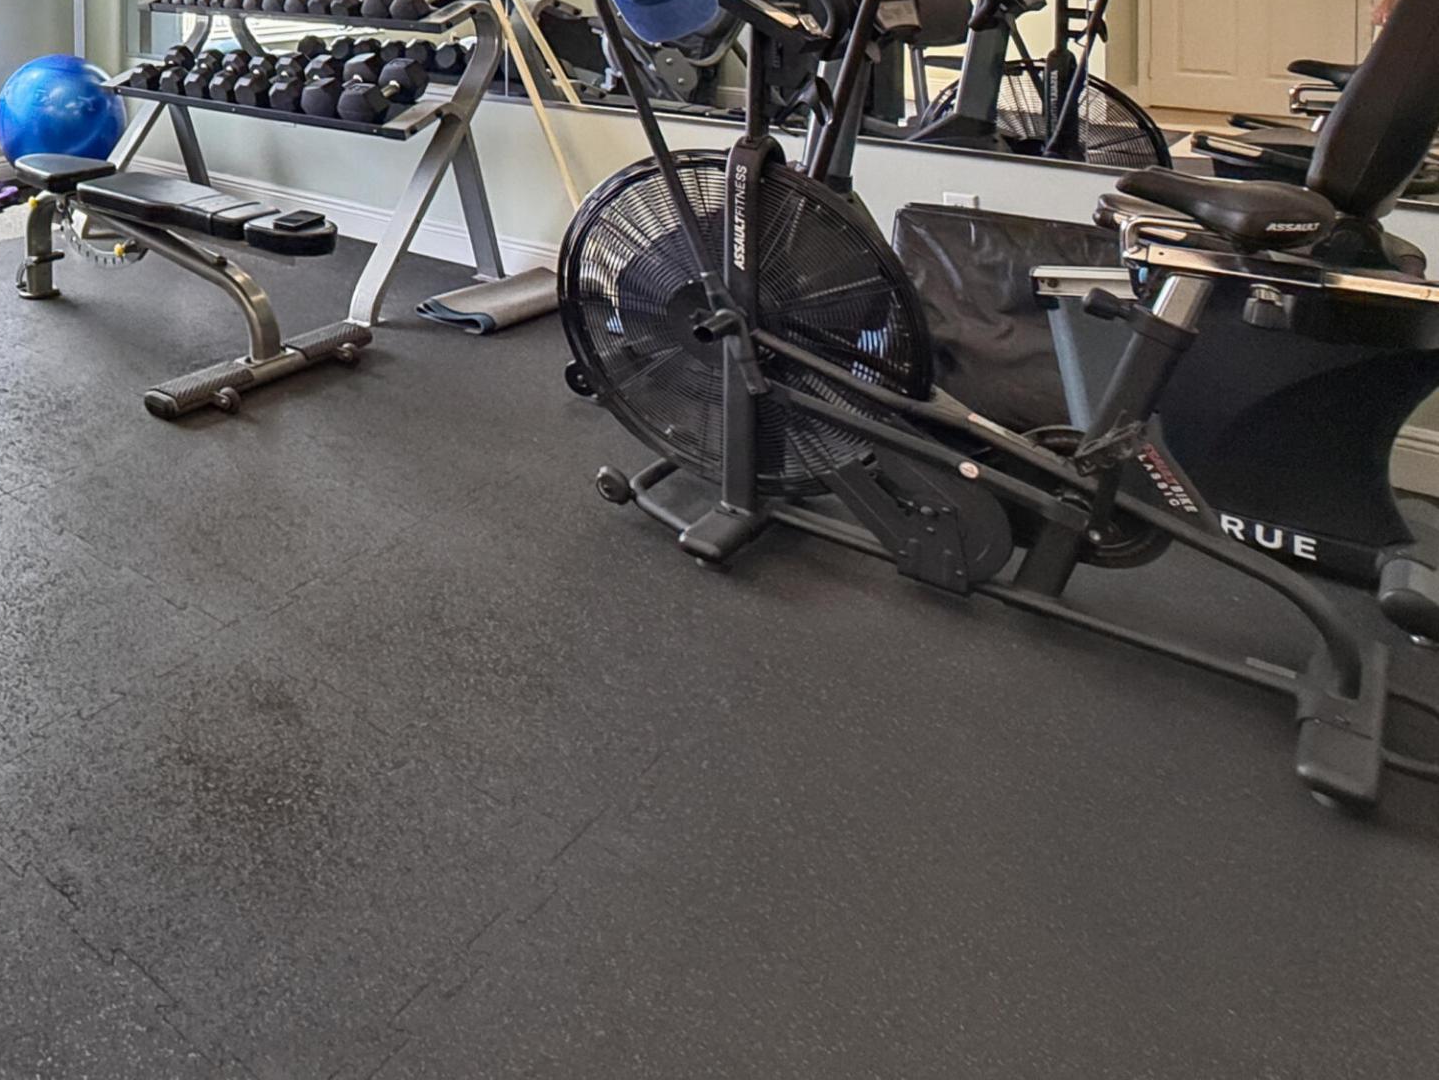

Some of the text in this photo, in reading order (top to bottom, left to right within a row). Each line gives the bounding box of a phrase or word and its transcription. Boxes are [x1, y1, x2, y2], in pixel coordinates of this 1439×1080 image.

[1265, 221, 1321, 232] ASSAULT
[1137, 454, 1181, 507] LASSIC
[1220, 513, 1317, 561] RUE
